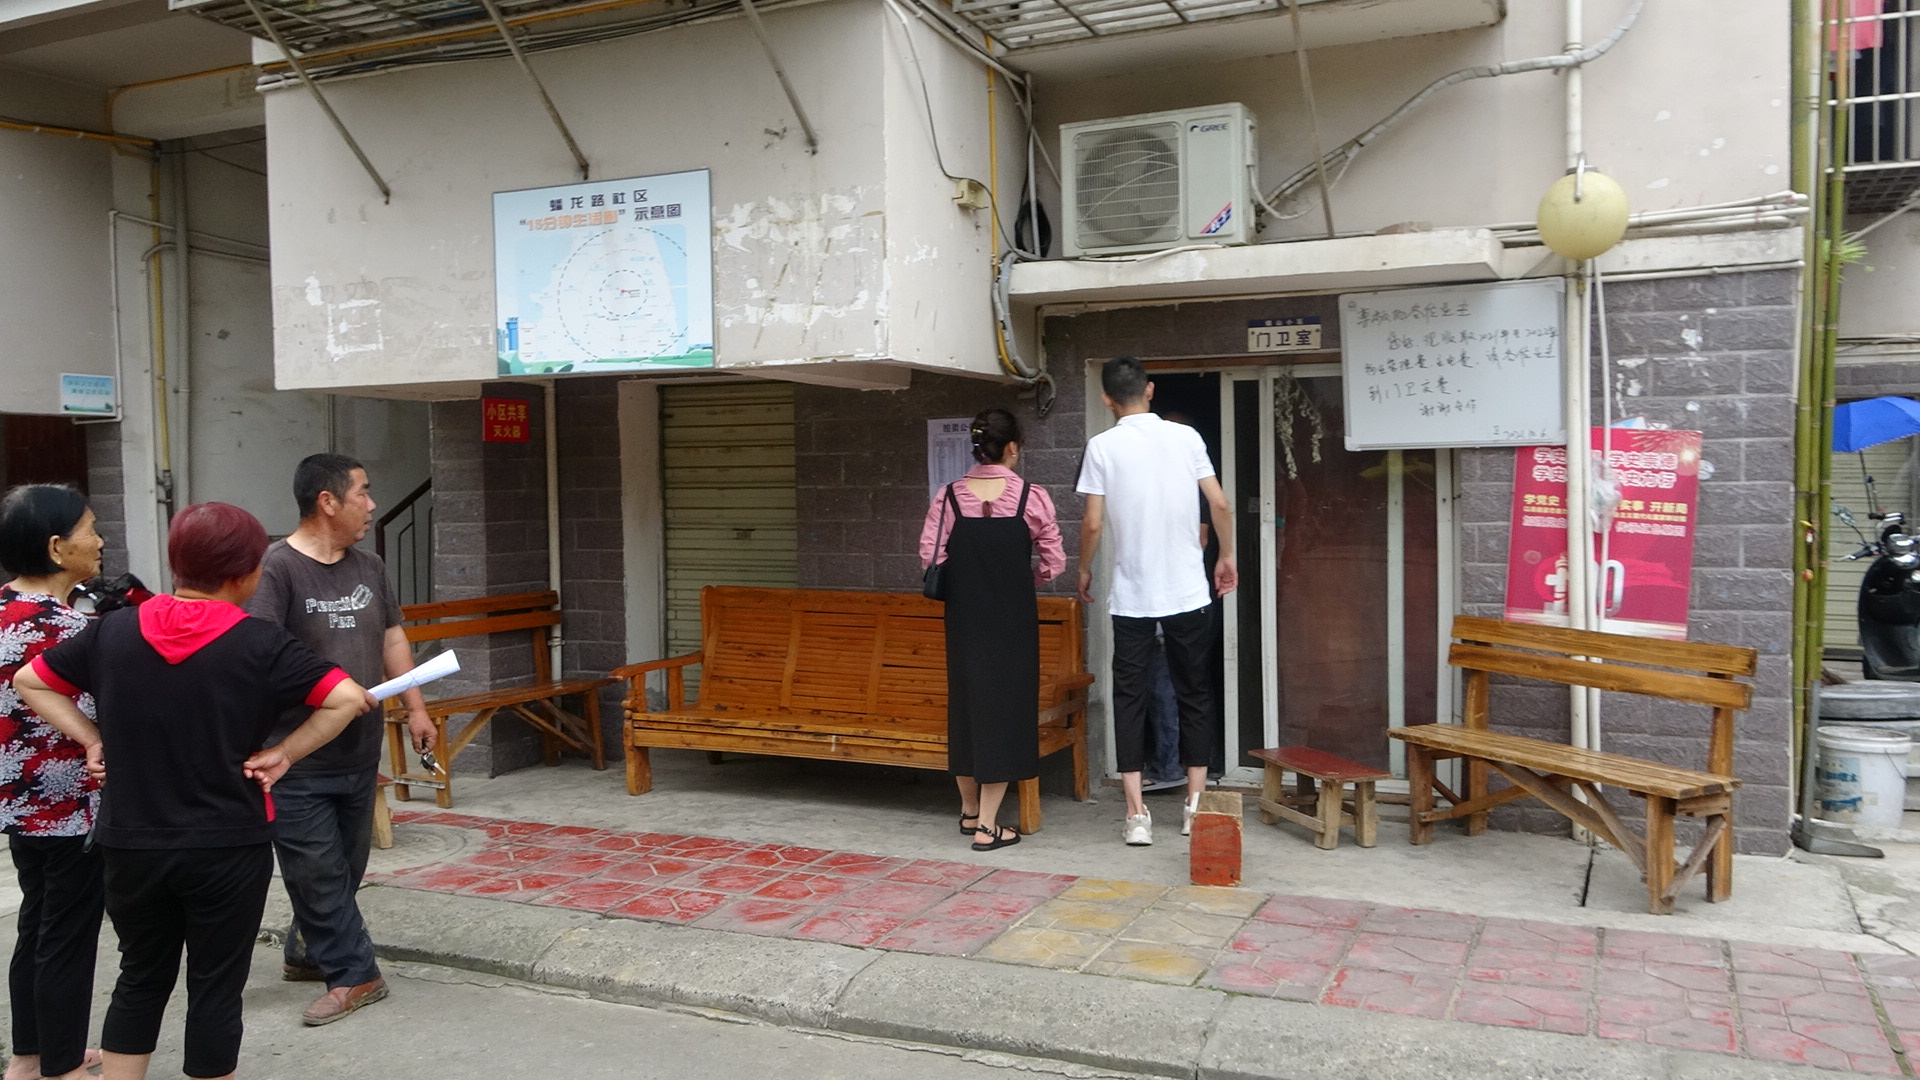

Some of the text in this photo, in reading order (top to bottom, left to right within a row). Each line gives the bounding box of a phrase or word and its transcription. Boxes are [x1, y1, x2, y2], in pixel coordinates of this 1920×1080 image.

[1200, 122, 1229, 132] GREE
[549, 189, 647, 212] 蟠龙路社区
[634, 203, 682, 222] 示意图
[1256, 329, 1312, 348] 门卫室
[486, 402, 528, 423] 小区共享
[492, 424, 522, 439] 灭火器
[1609, 450, 1679, 470] 学史崇德
[1522, 493, 1560, 506] 学党史
[1649, 501, 1689, 515] 开新局
[328, 613, 356, 629] Pen
